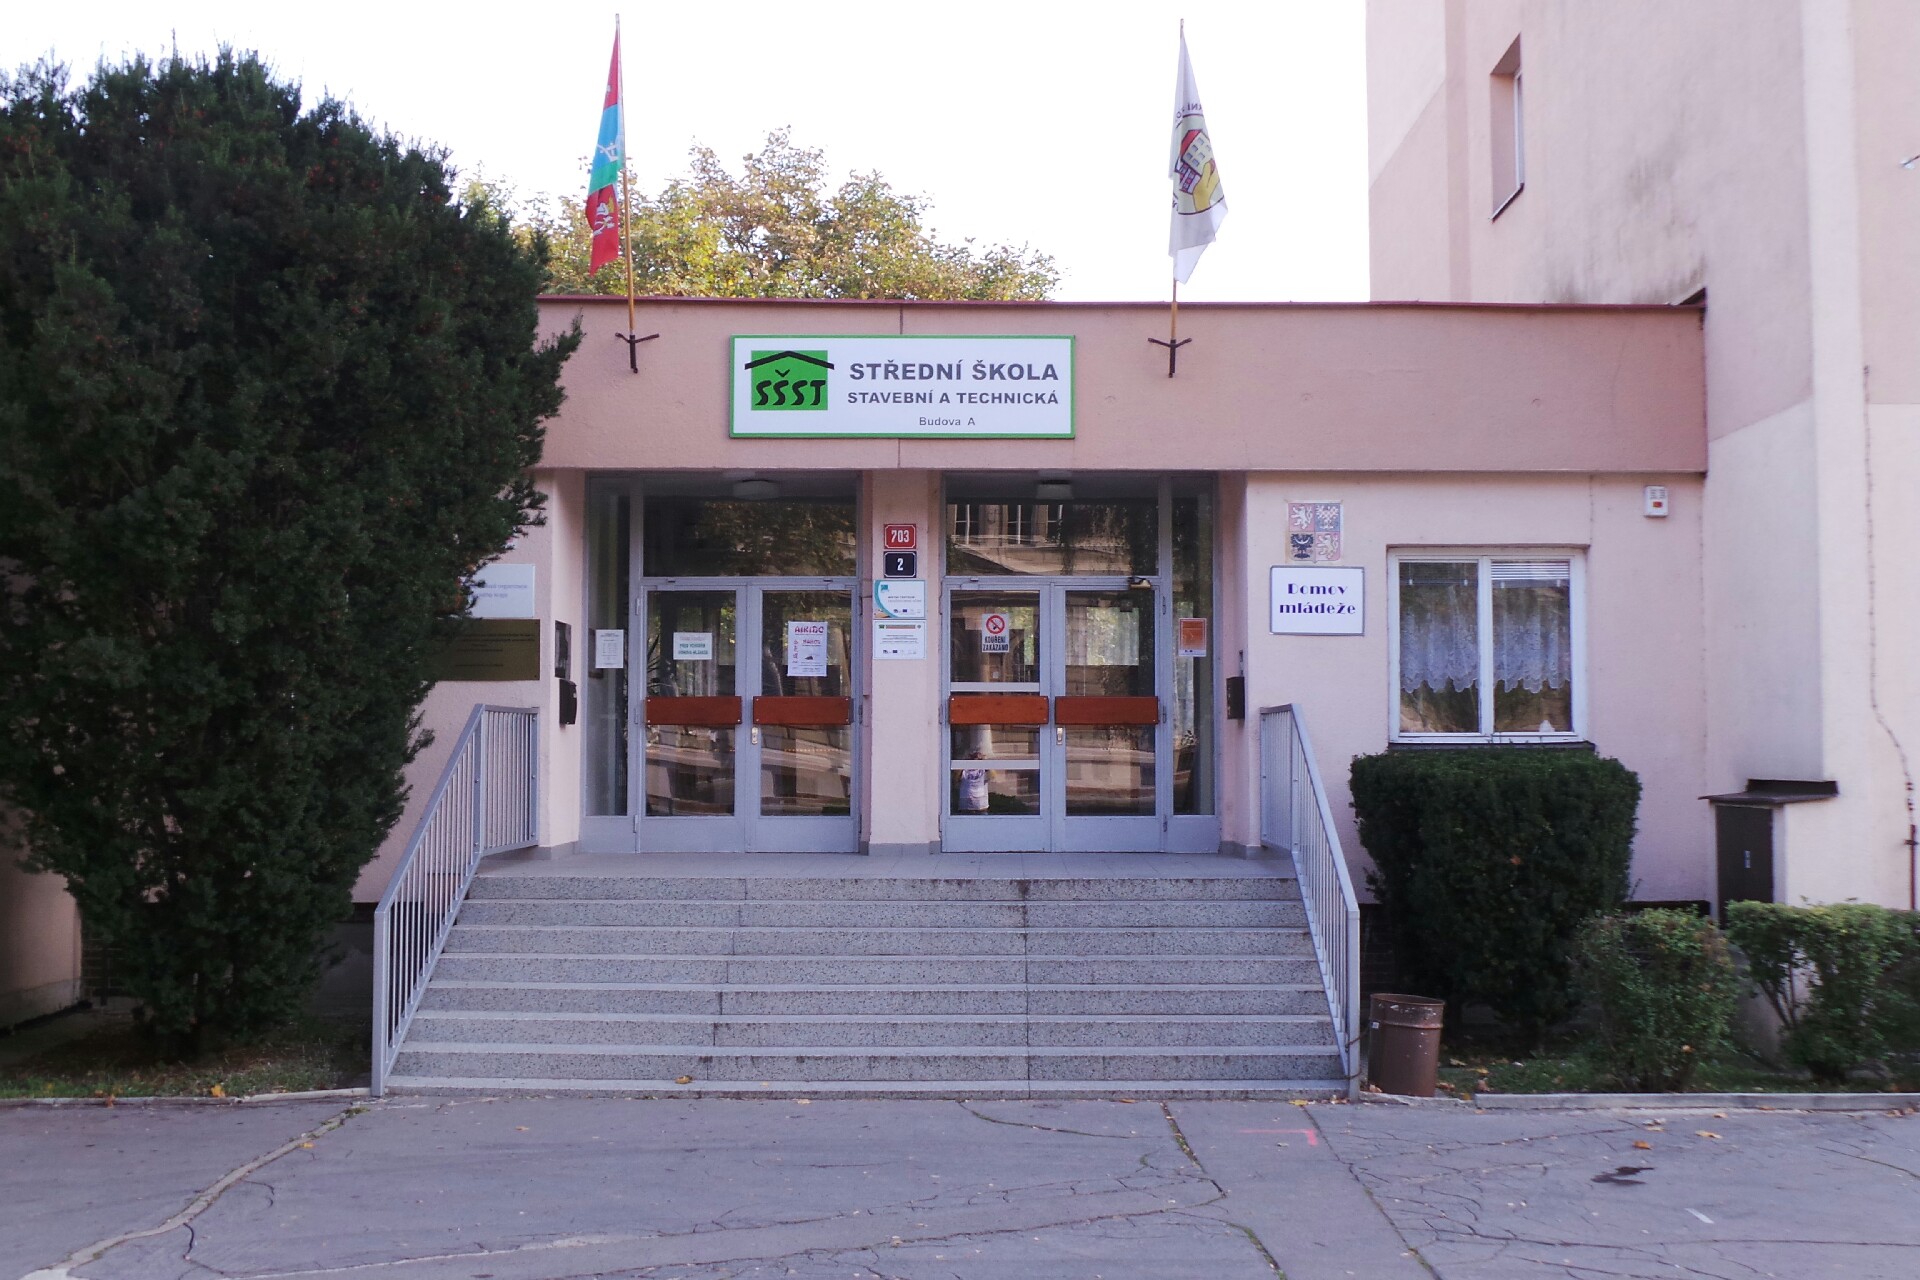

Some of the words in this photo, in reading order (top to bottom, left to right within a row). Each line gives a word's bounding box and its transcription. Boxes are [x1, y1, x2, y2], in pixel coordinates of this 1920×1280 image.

[849, 359, 962, 381] STŘEDNÍ
[972, 359, 1059, 381] ŠKOLA
[755, 369, 826, 406] SŠST
[847, 390, 933, 405] STAVEBNÍ
[939, 392, 951, 405] A
[956, 390, 1059, 405] TECHNICKÁ
[919, 416, 961, 428] Budova
[967, 417, 976, 428] A
[891, 529, 910, 543] 703
[897, 557, 904, 571] 2
[1287, 582, 1348, 596] Domov
[1279, 601, 1356, 615] mládeže
